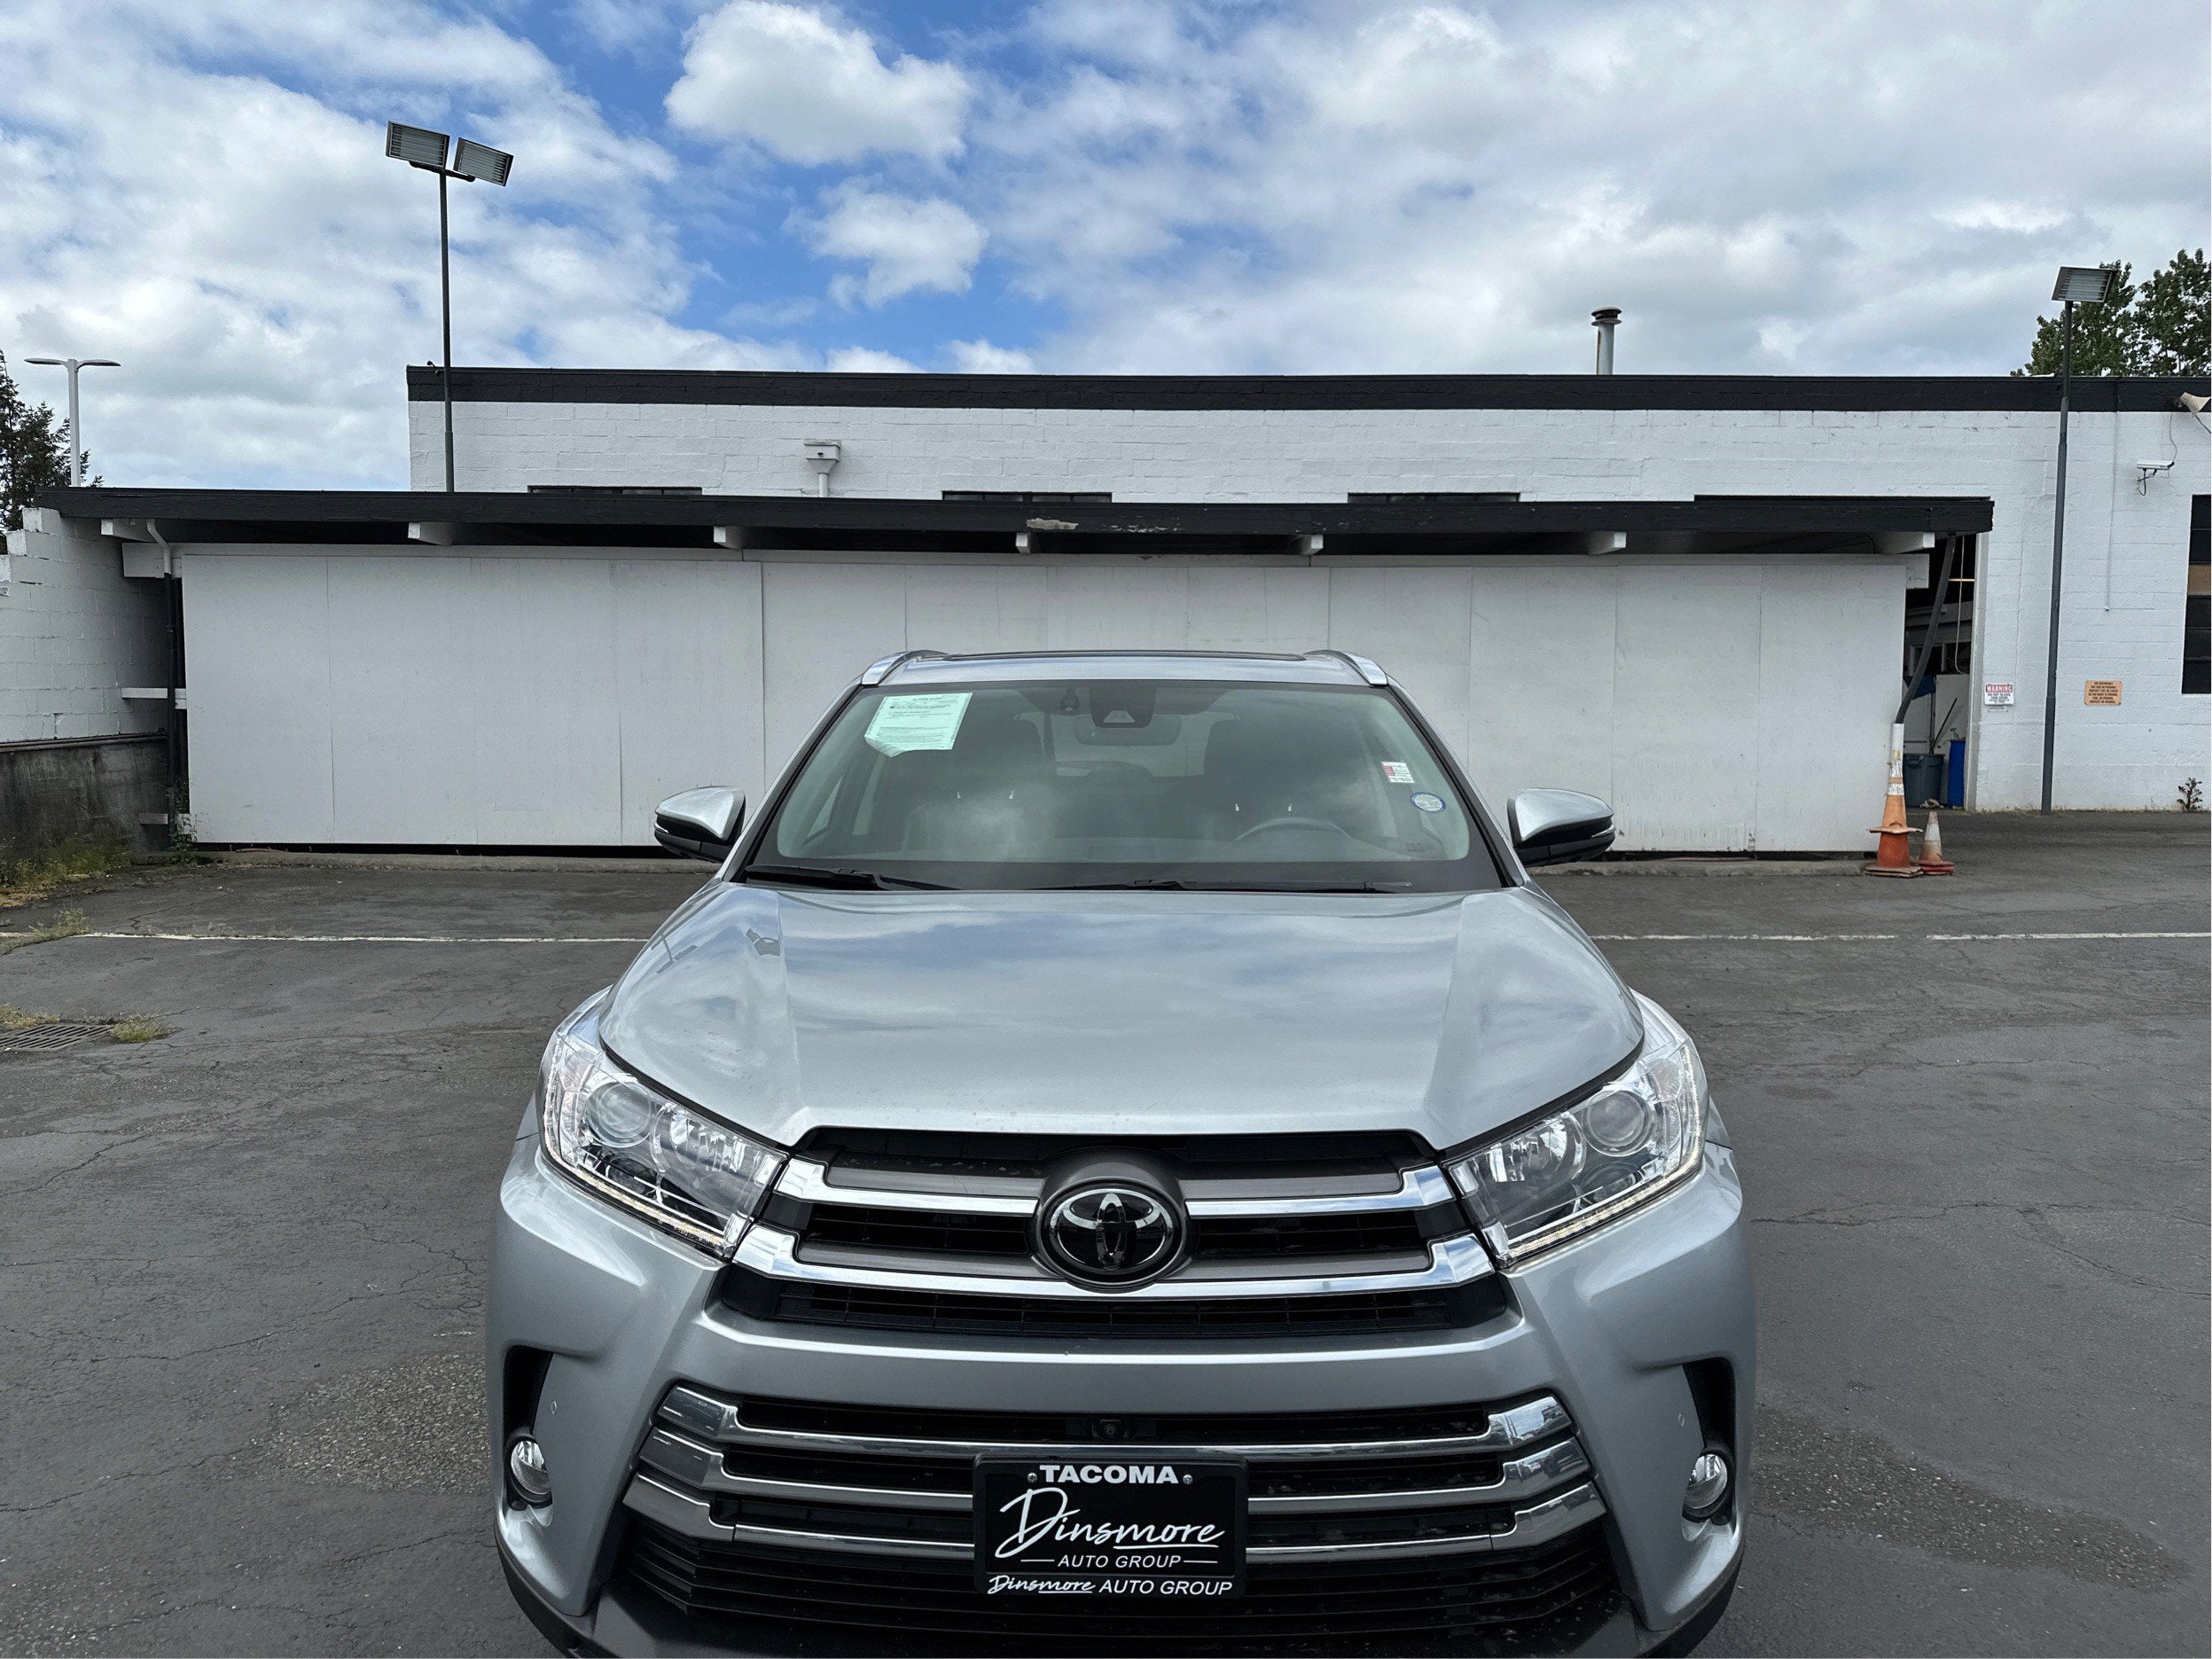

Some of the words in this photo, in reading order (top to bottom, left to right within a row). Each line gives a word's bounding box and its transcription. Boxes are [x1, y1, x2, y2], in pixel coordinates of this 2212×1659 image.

[1986, 684, 2013, 693] WARNING
[1039, 1465, 1179, 1484] TACOMA
[995, 1487, 1225, 1558] Dinsmore
[1058, 1555, 1108, 1568] AUTO
[1115, 1555, 1181, 1569] GROUP
[987, 1575, 1096, 1594] Dinsmore
[1098, 1579, 1154, 1594] AUTO
[1160, 1580, 1232, 1595] GROUP
